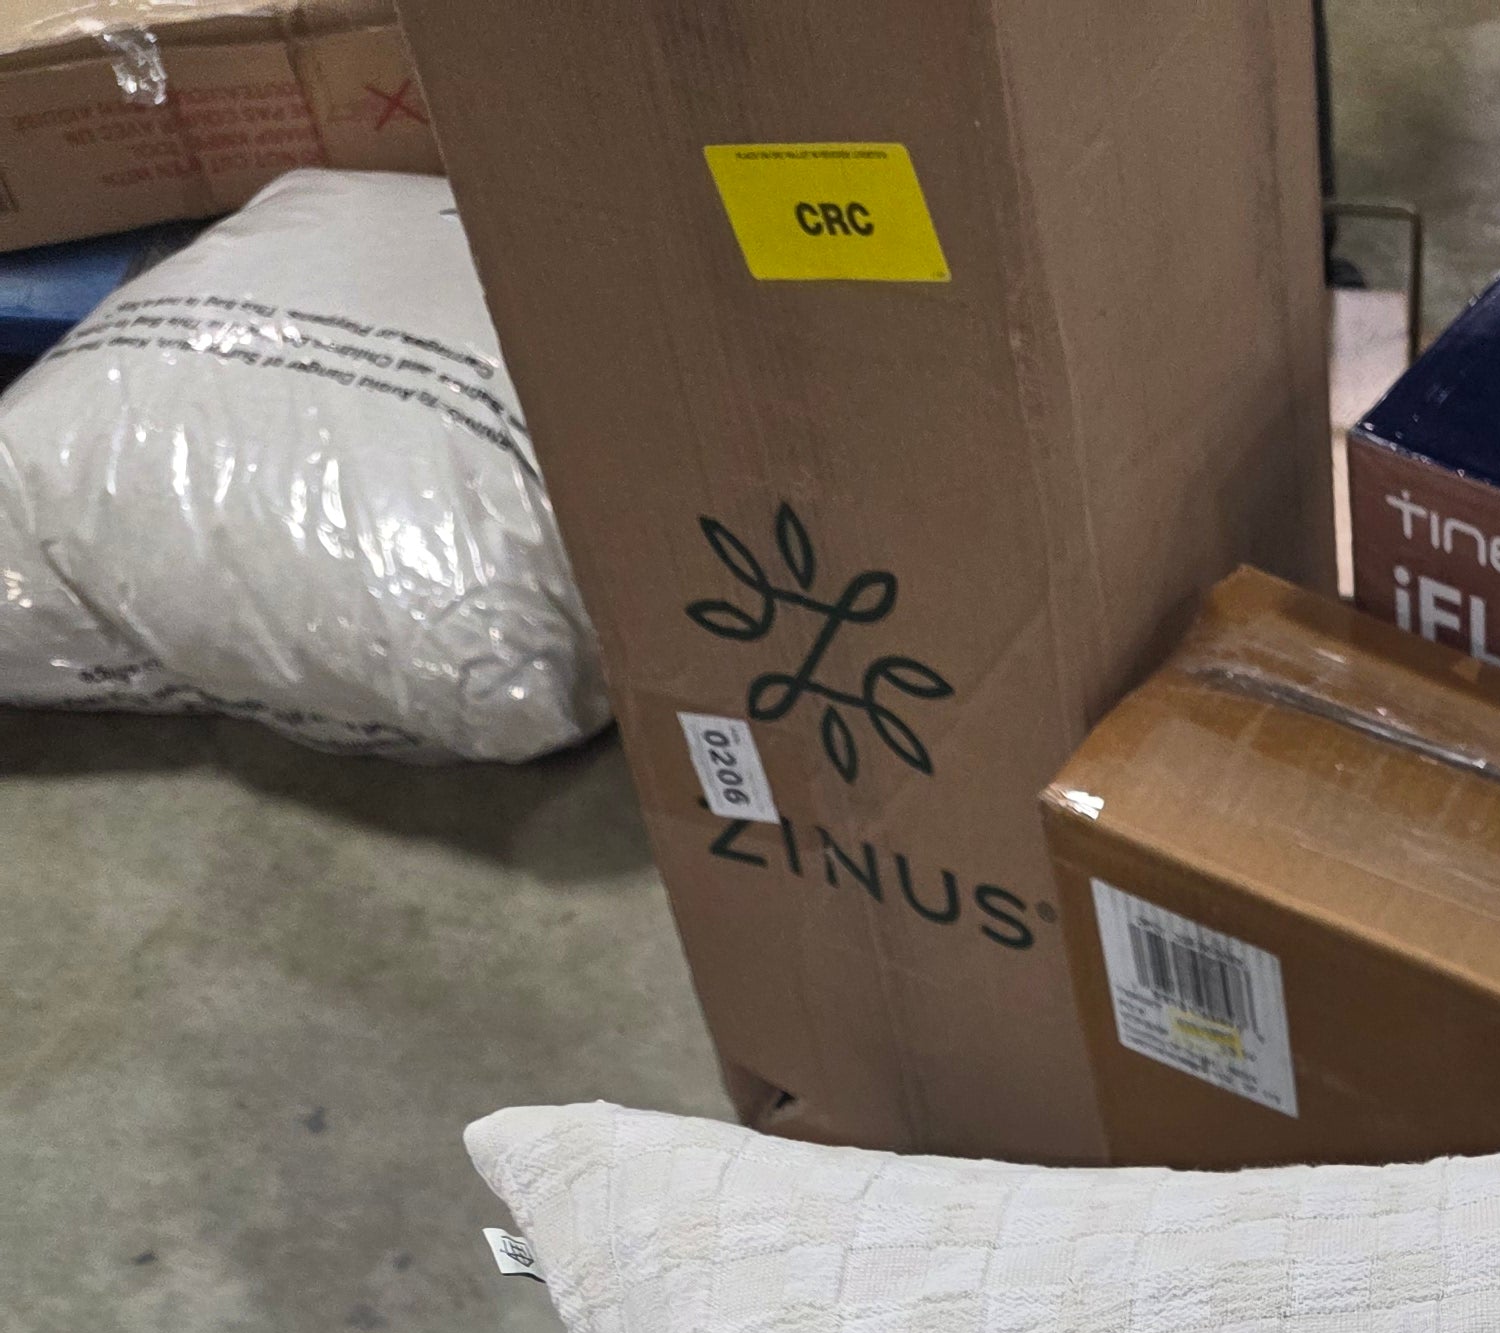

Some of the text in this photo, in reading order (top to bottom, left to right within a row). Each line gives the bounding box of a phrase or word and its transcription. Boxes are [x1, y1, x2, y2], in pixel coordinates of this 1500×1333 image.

[795, 202, 874, 236] CRC
[703, 729, 751, 806] 0206
[699, 795, 1034, 949] ZINUS
